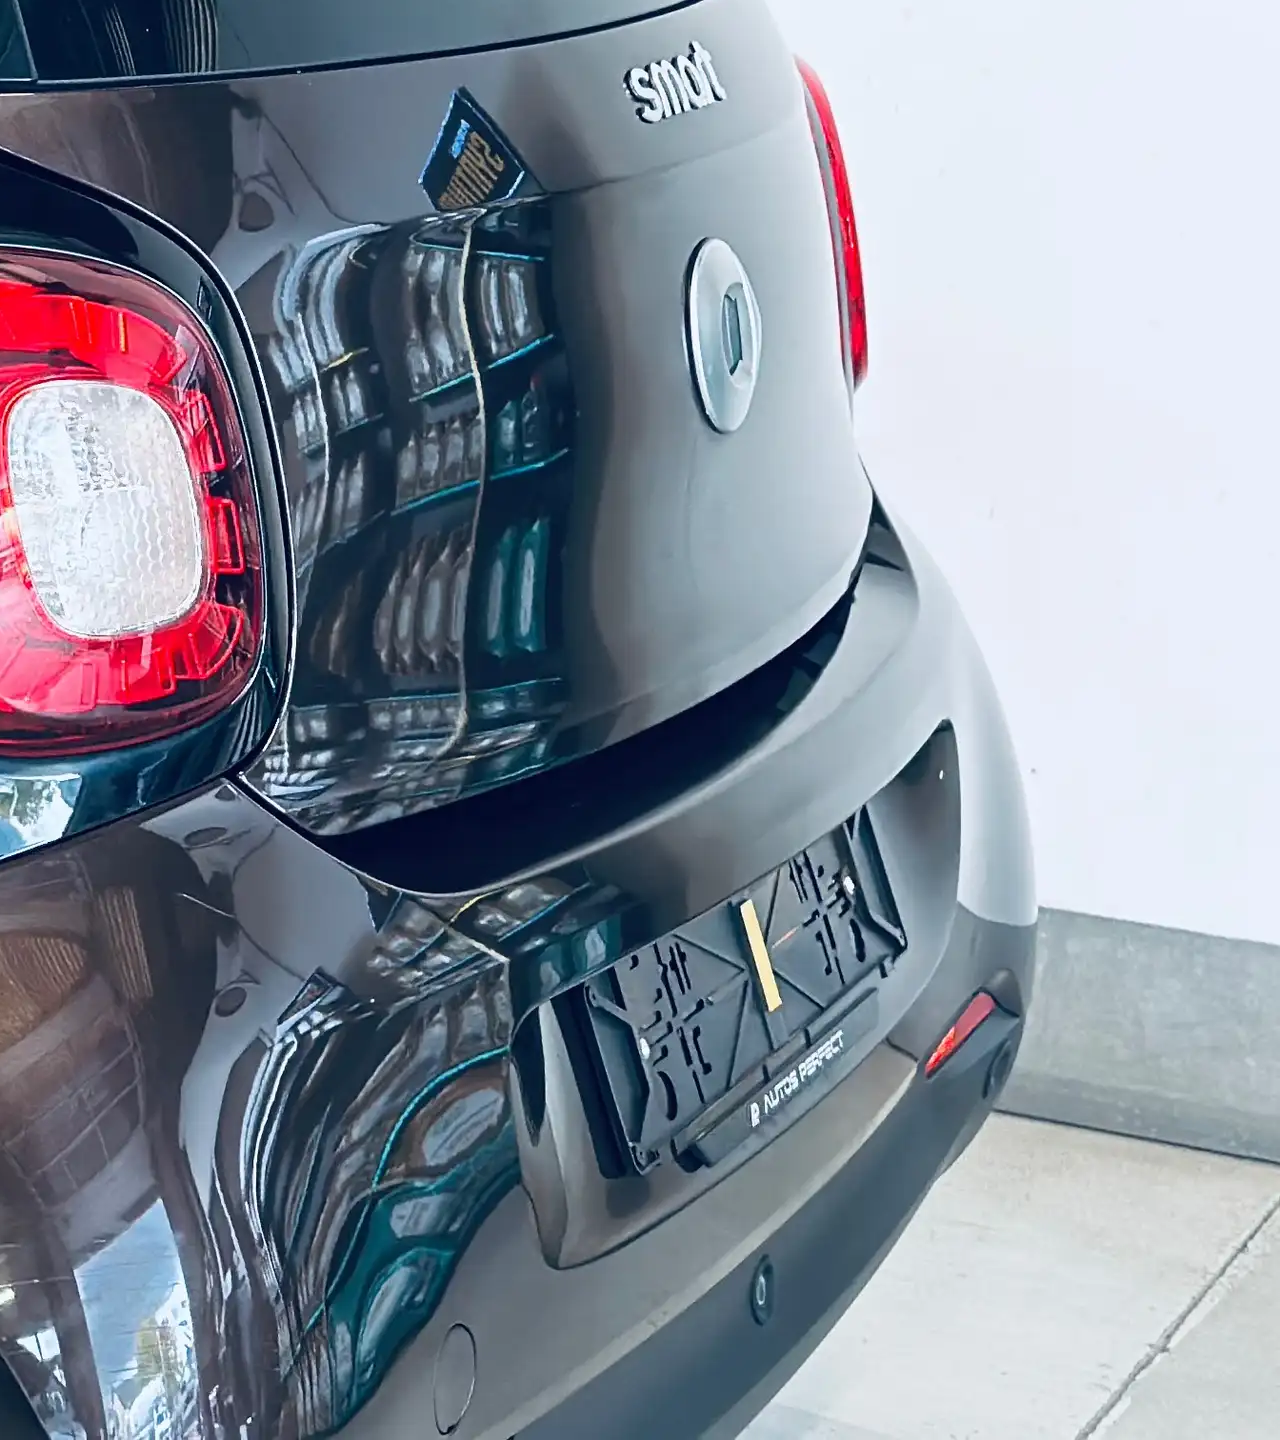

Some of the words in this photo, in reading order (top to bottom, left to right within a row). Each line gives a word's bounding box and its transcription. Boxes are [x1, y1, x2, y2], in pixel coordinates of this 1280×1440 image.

[624, 40, 727, 124] smart
[763, 1069, 799, 1114] AUTOS
[798, 1029, 844, 1082] PERFECT
